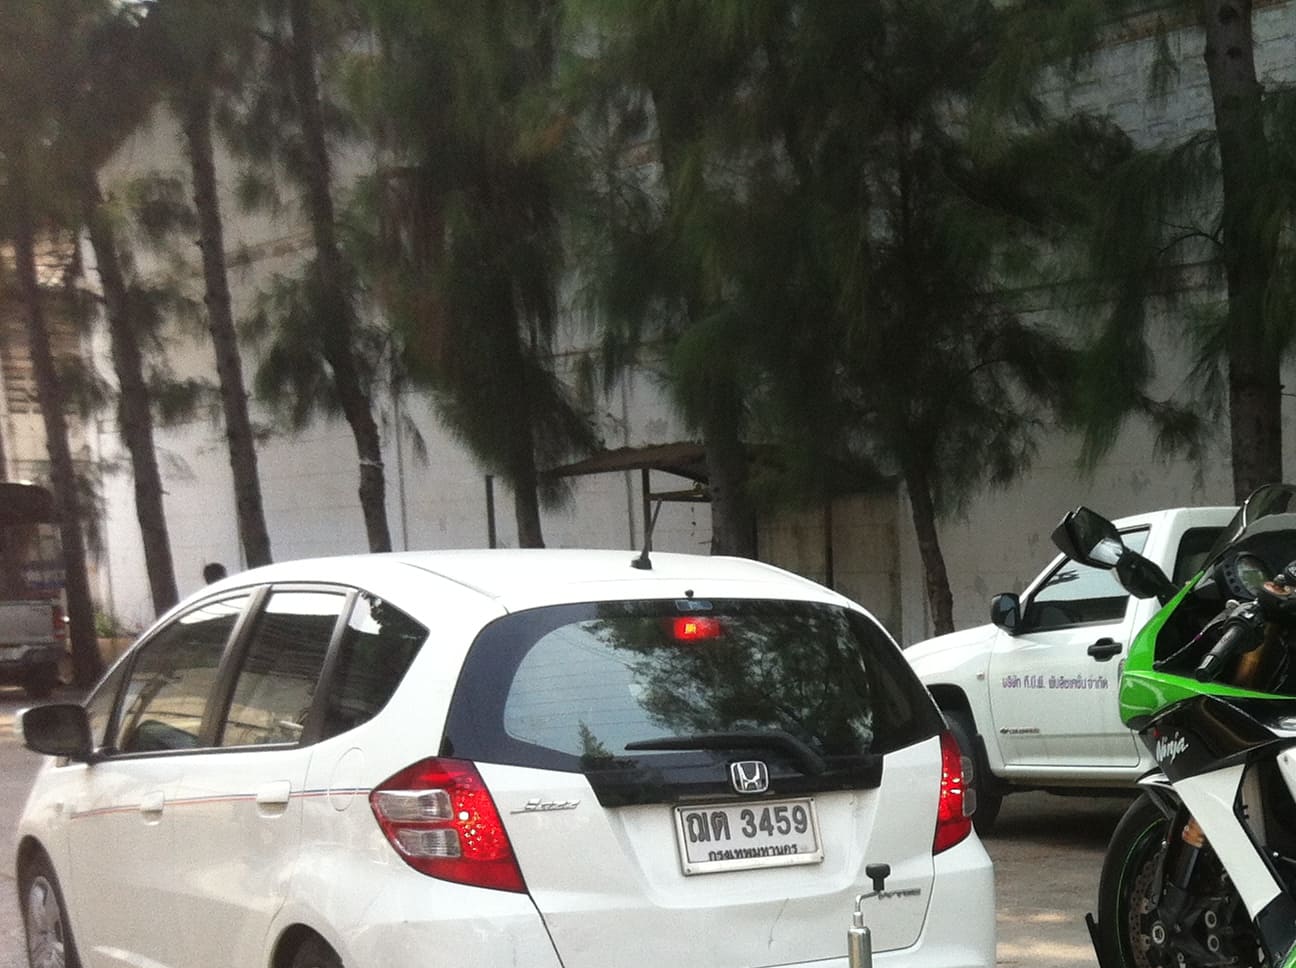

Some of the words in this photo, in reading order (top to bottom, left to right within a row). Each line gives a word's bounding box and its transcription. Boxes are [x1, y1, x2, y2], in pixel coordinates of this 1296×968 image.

[1156, 731, 1189, 765] Ninja
[740, 805, 808, 838] 3459
[708, 843, 798, 861] กรงเทพมหานคร
